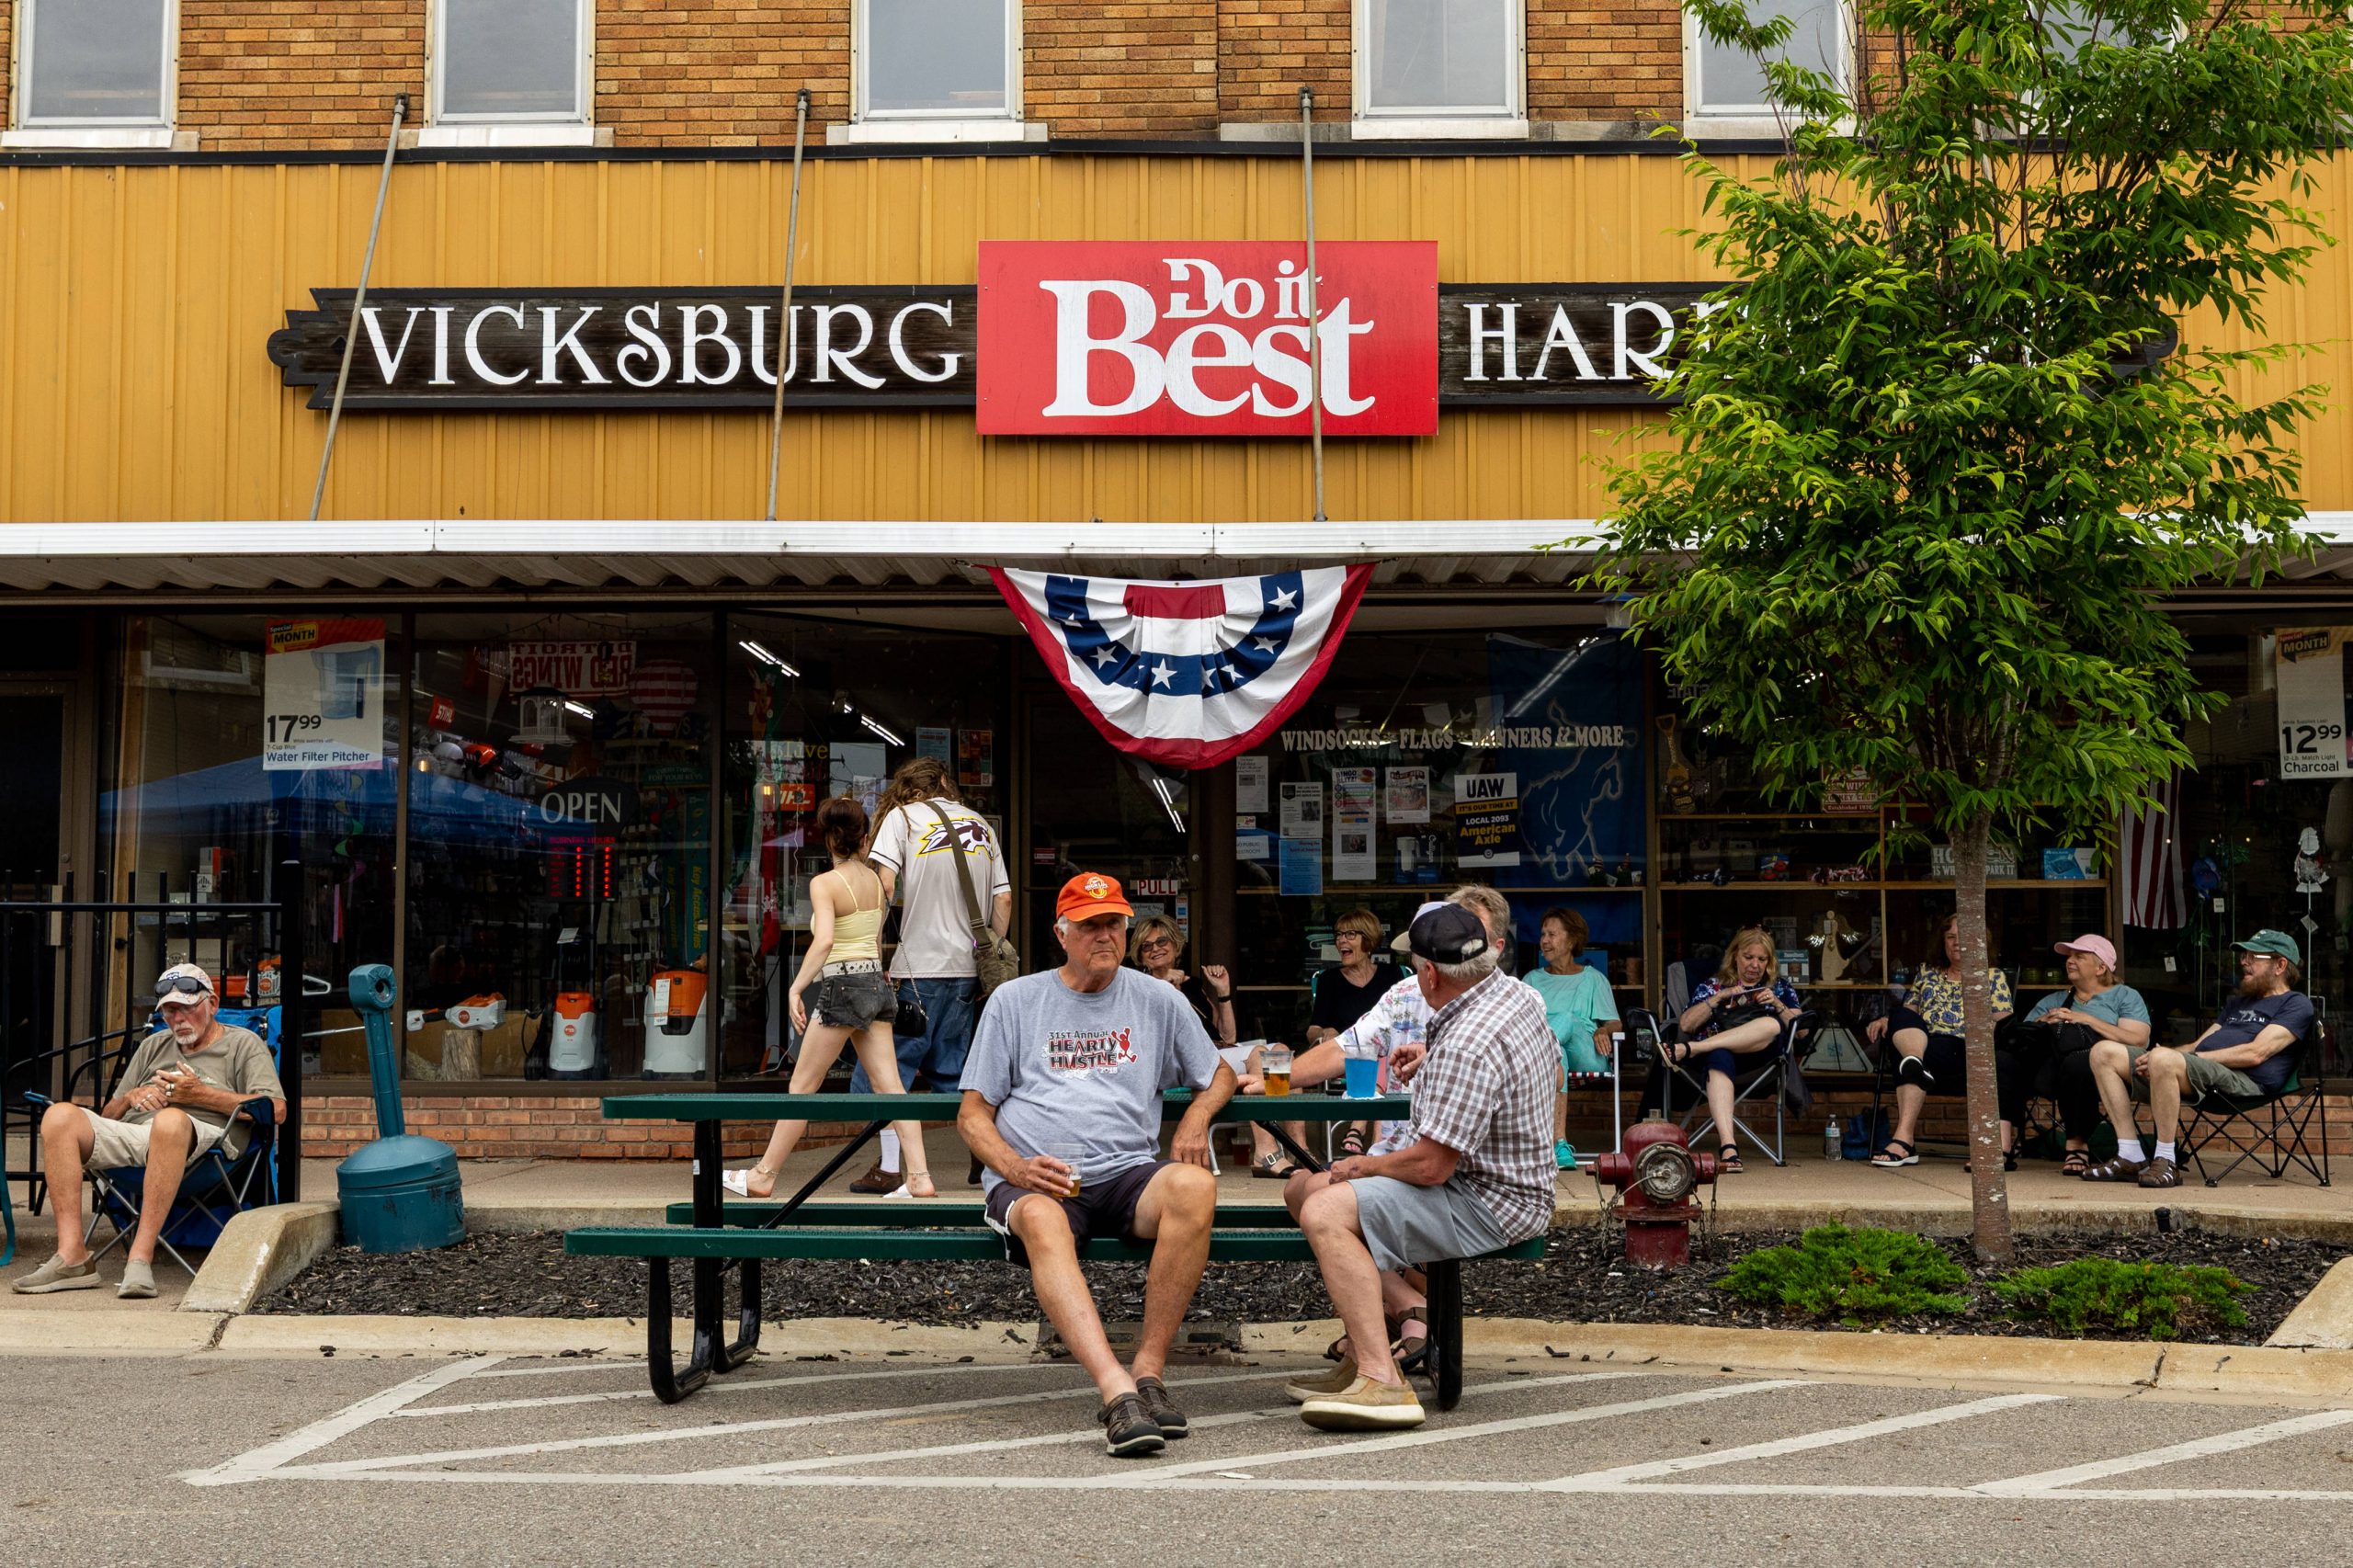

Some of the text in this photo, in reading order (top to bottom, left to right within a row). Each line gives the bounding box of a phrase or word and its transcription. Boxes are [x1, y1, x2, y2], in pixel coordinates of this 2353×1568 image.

[1163, 257, 1324, 320] Do it
[360, 299, 964, 390] VICKSBURG
[1040, 280, 1377, 418] Best
[273, 629, 315, 643] MONTH
[2283, 635, 2328, 653] MONTH
[1280, 724, 1624, 752] WINDSOCKS FLAGS BANNERS & MORE
[267, 750, 369, 762] Water Filter Pitcher
[2284, 761, 2339, 773] Charcoal
[1466, 778, 1505, 799] UAW
[540, 791, 621, 824] OPEN
[1465, 814, 1509, 825] LOCAL 2093
[1460, 824, 1516, 837] American
[586, 836, 616, 845] HOURS
[1427, 834, 1437, 863] Culligan
[1474, 834, 1501, 846] Axle
[691, 867, 701, 885] Key
[1985, 864, 2005, 876] PARK
[2006, 864, 2016, 876] IT
[1138, 878, 1176, 895] PULL
[1049, 1031, 1071, 1040] 31ST
[1049, 1037, 1118, 1054] HEARTY
[1050, 1053, 1119, 1069] HUSTLE
